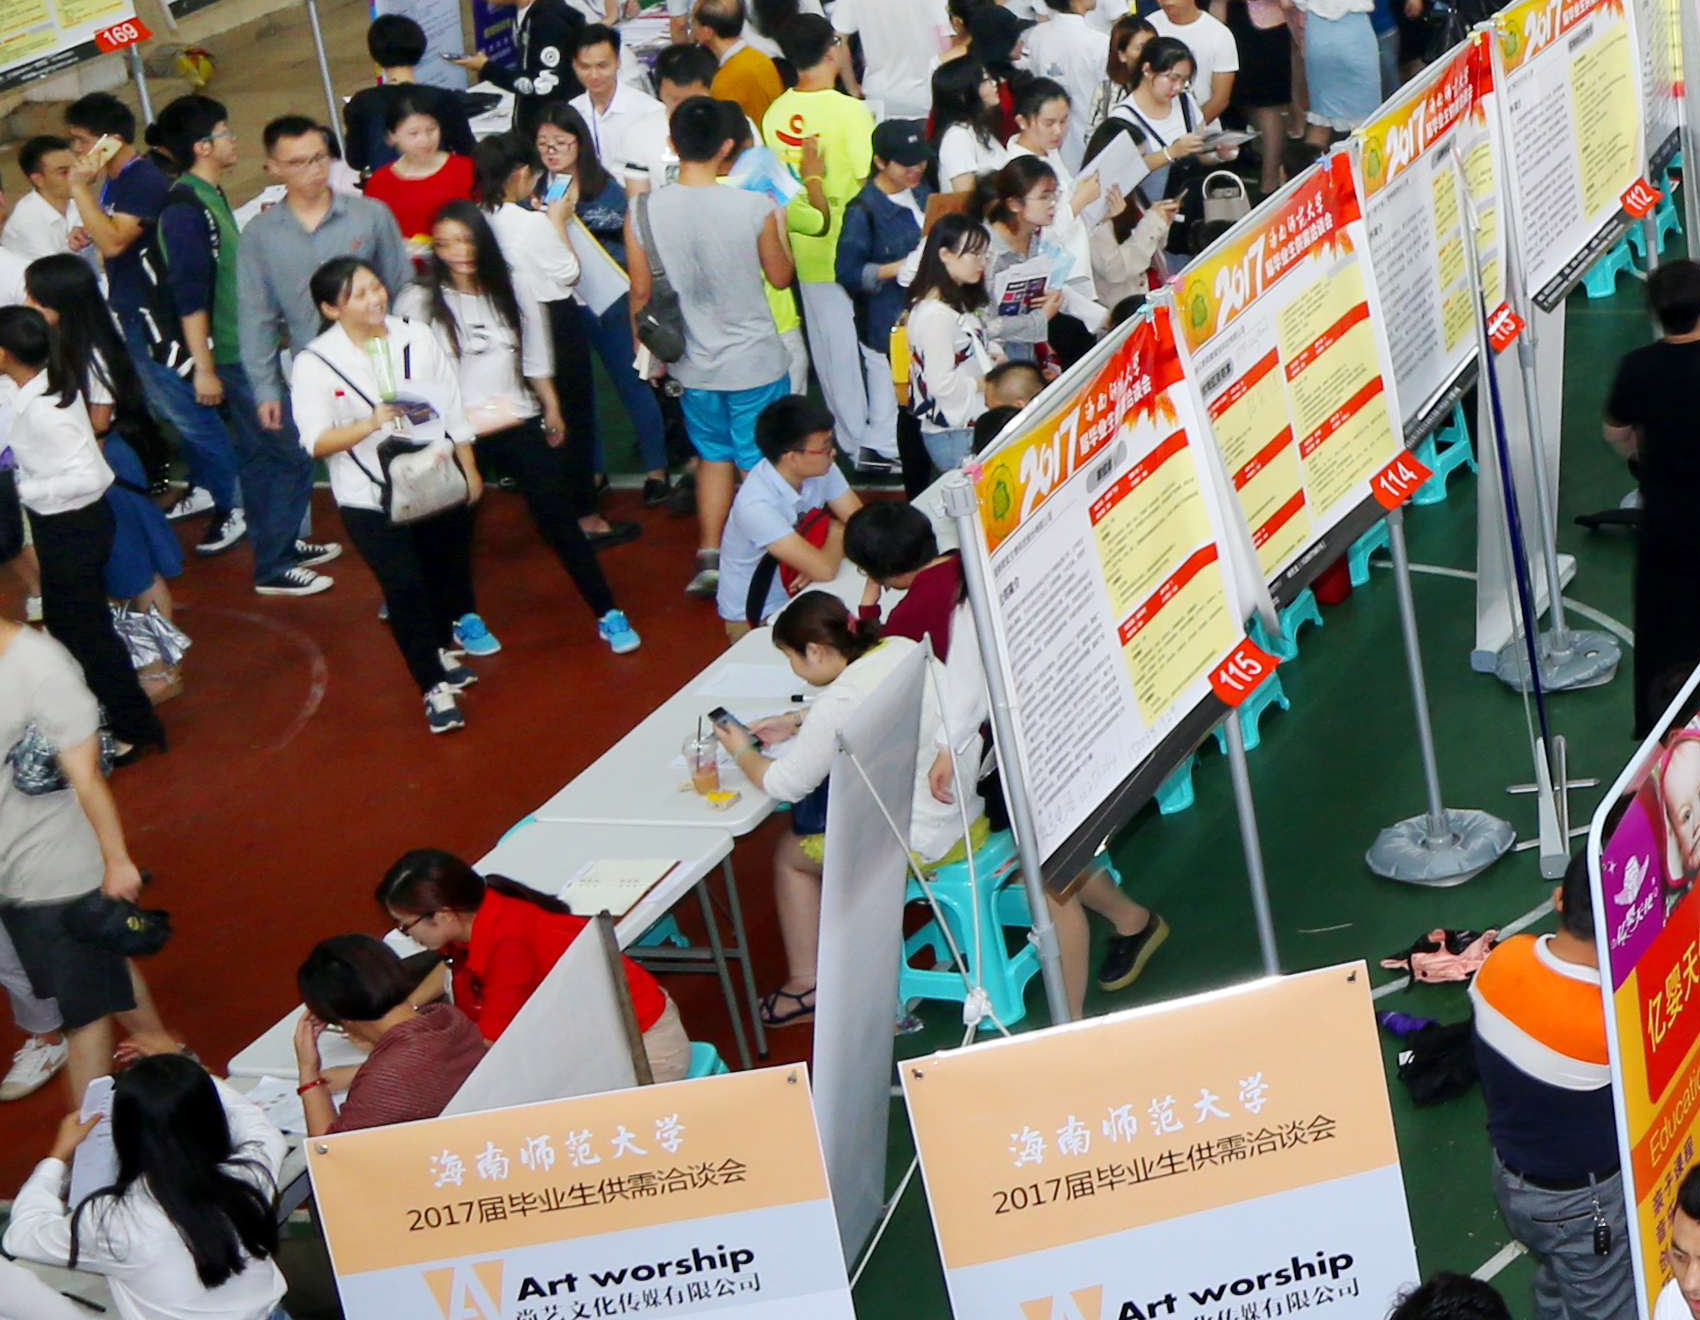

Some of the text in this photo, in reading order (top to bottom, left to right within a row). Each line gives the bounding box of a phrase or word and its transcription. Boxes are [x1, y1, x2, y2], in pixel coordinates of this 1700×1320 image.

[103, 23, 139, 46] 169
[1384, 99, 1427, 181] 2017
[1624, 185, 1654, 211] 112
[1213, 232, 1268, 331] 2017
[1017, 405, 1082, 526] 2017
[1379, 463, 1419, 497] 114
[1219, 650, 1262, 690] 115
[429, 1113, 687, 1189] 海南师范大学
[1008, 1071, 1271, 1169] 海南师范大学
[406, 1157, 748, 1232] 2017届毕业生供需洽谈会
[992, 1113, 1338, 1216] 2017届毕业生供需洽谈会
[1651, 1134, 1696, 1219] 亲子课程
[516, 1242, 756, 1303] Art worship
[1115, 1249, 1355, 1320] Art worship
